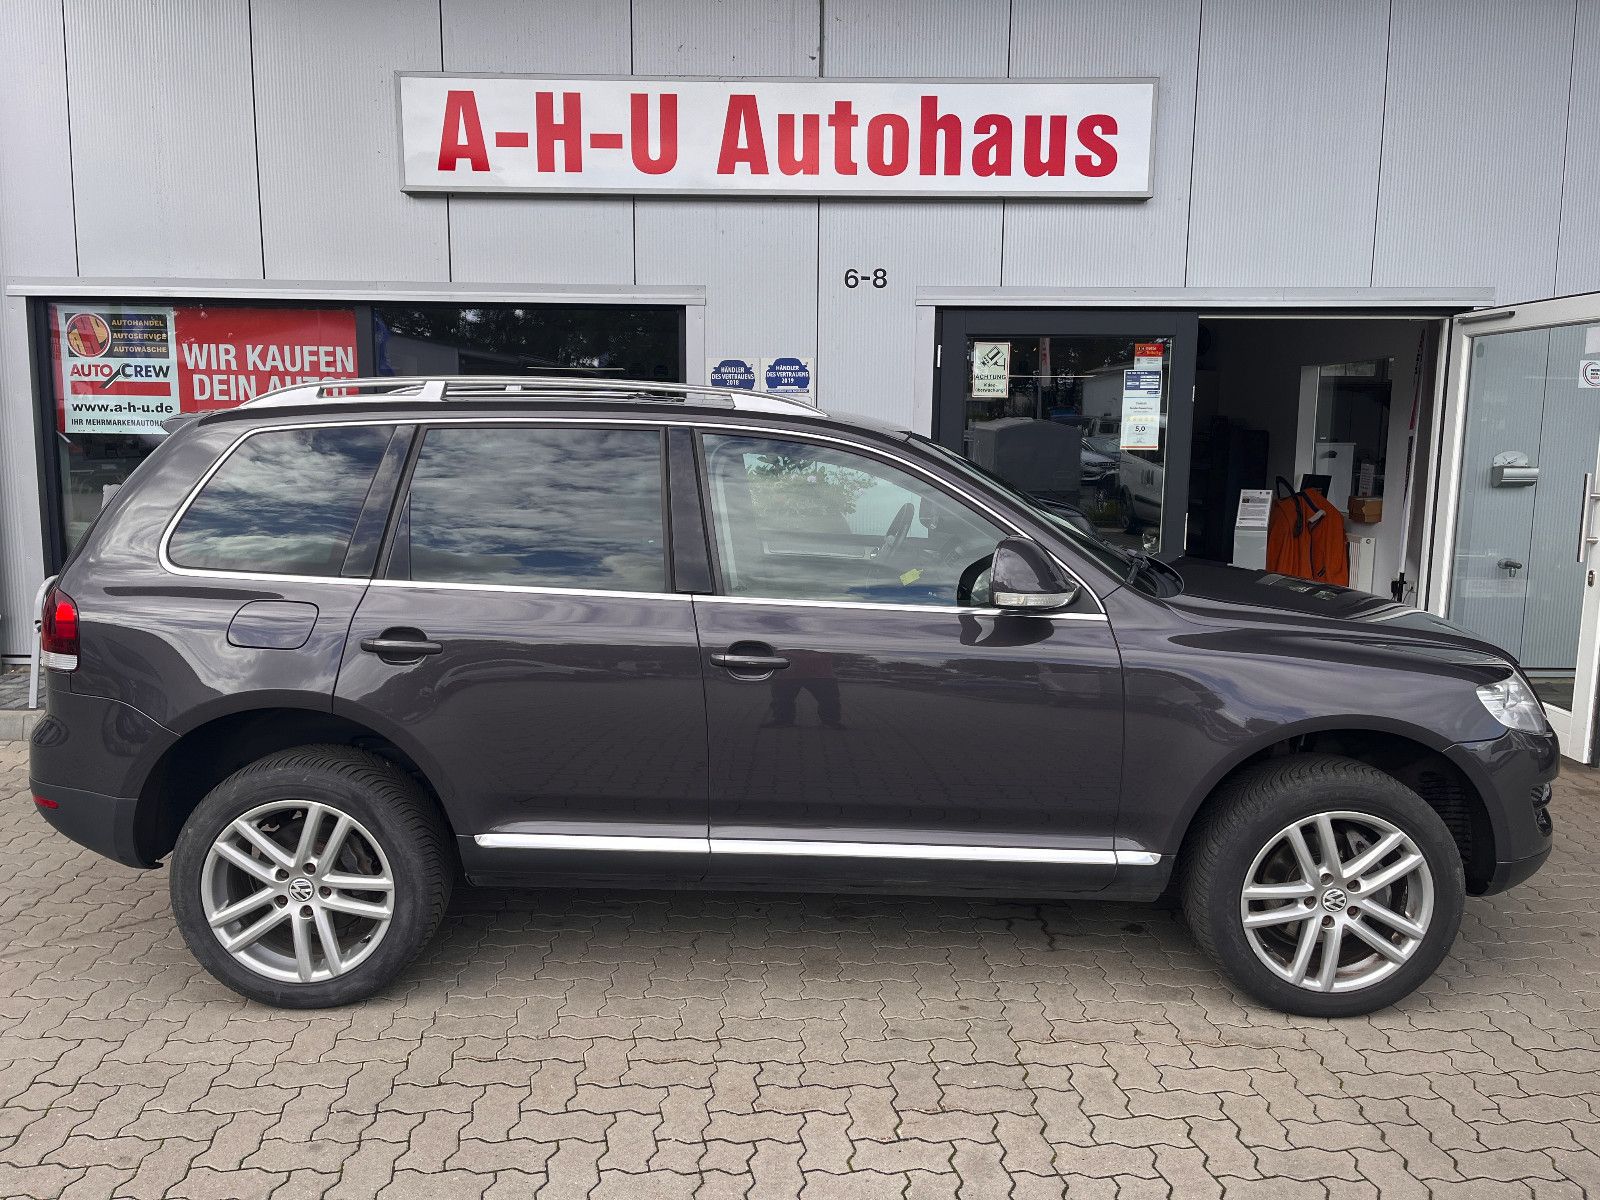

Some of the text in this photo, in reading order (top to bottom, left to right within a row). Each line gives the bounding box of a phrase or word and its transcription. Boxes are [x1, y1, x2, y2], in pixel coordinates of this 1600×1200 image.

[438, 90, 1118, 178] A-H-U Autohaus
[844, 268, 888, 289] 6-8
[111, 319, 164, 327] AUTOHANDEL
[112, 332, 168, 341] AUTOSERVICE
[182, 343, 354, 373] WIR KAUFEN
[193, 374, 257, 401] DEIN
[72, 402, 173, 414] www.a-h-u.de
[71, 418, 84, 426] IHR
[1134, 425, 1146, 433] 5,0
